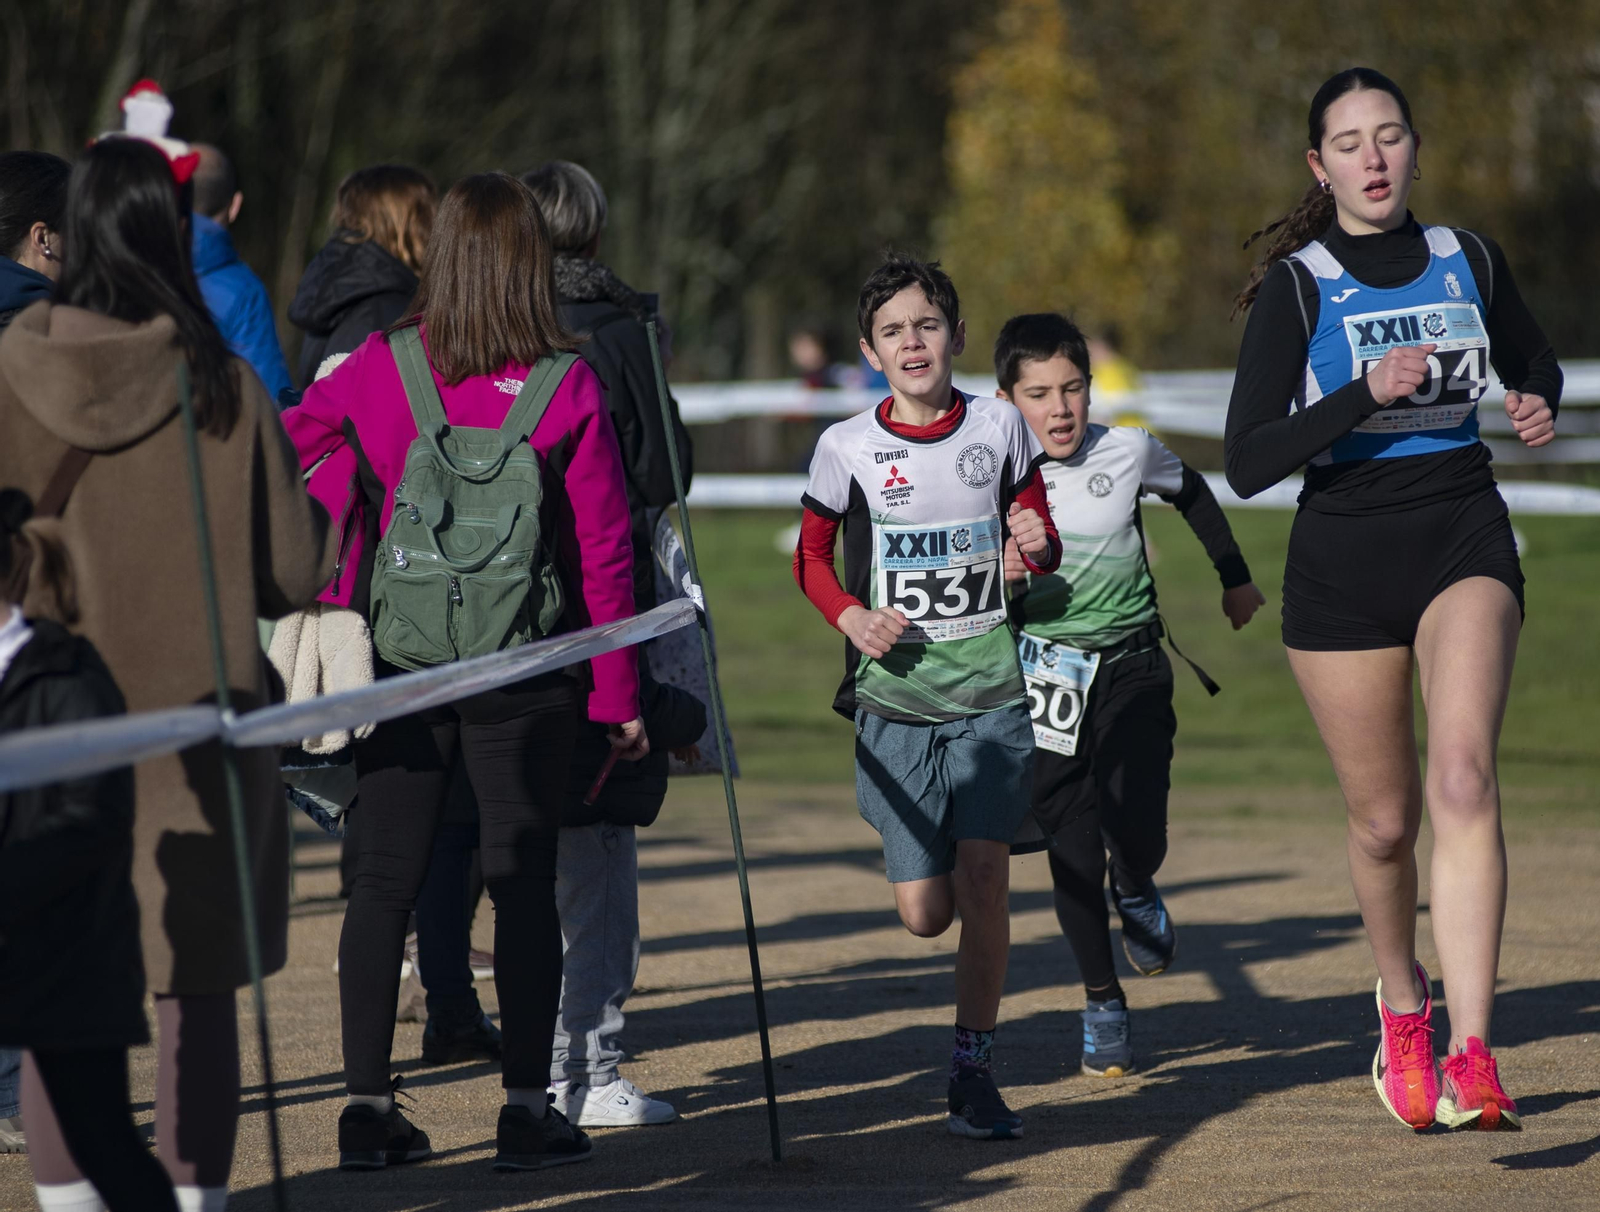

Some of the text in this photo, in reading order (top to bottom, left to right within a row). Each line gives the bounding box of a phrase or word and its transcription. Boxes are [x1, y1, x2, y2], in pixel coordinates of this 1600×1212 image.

[1353, 315, 1421, 346] XXII
[1358, 345, 1388, 353] CARREIRA
[504, 377, 518, 385] THE
[1367, 350, 1487, 405] 04
[494, 380, 517, 390] NORTH
[498, 386, 517, 395] FACE
[880, 485, 915, 496] MITSUBISHI
[885, 492, 911, 501] MOTORS
[884, 531, 947, 558] XXII
[893, 561, 996, 619] 537
[1023, 674, 1082, 731] 50
